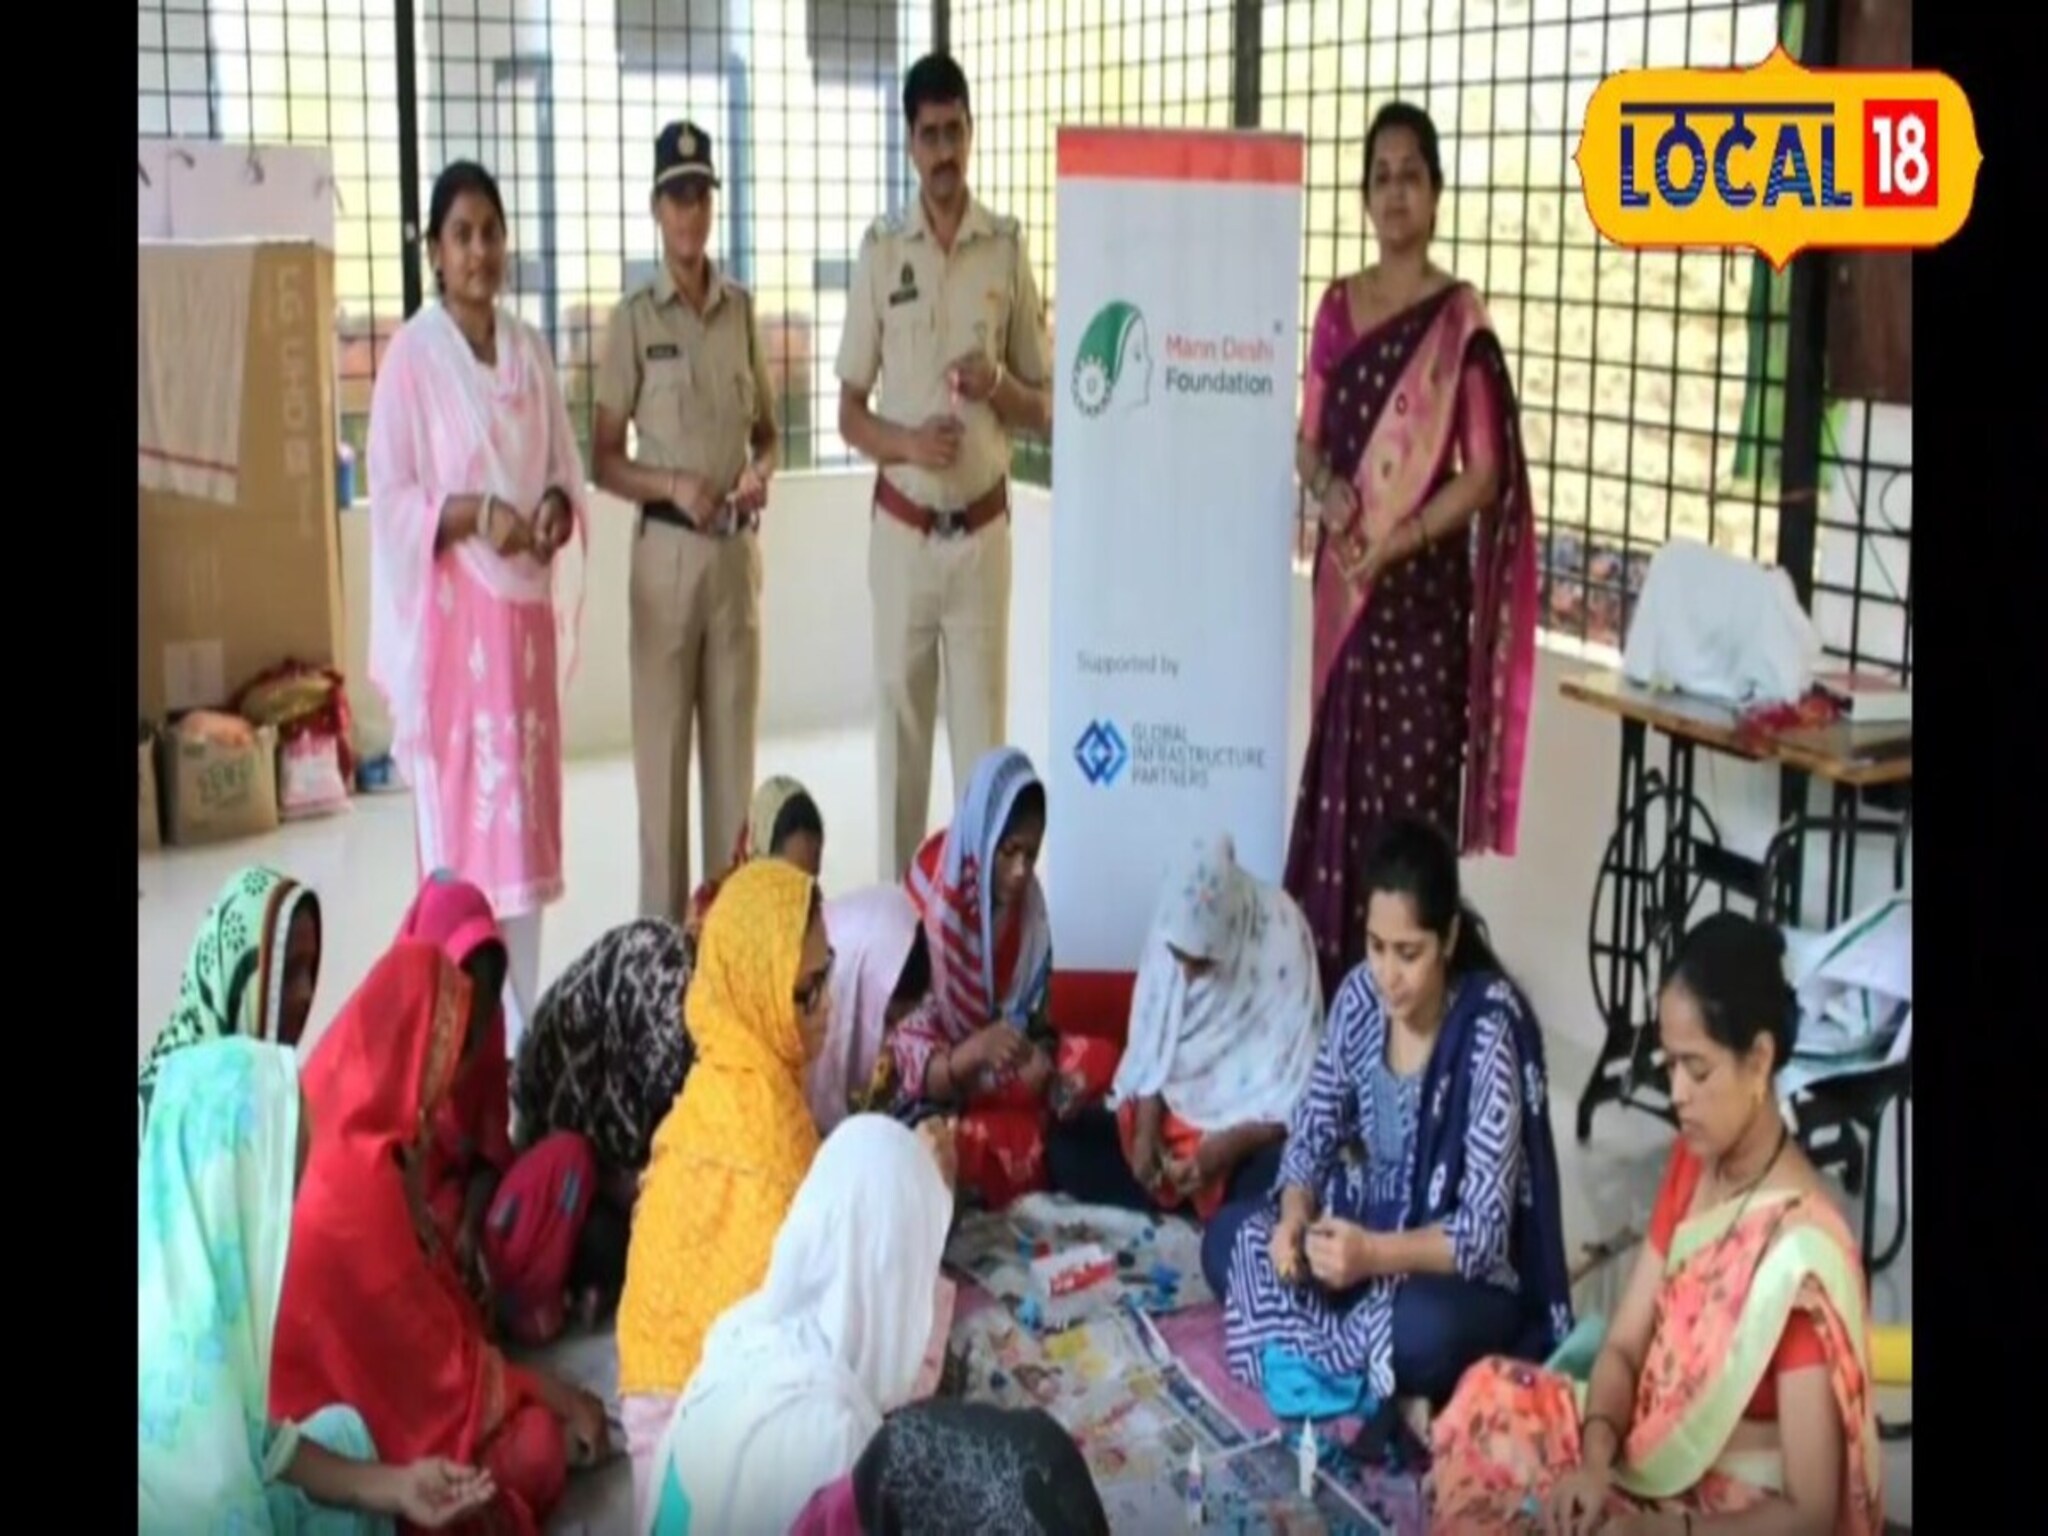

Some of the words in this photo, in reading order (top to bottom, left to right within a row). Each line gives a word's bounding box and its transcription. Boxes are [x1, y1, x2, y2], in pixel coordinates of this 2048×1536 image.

[1165, 333, 1217, 359] Mann
[1222, 335, 1274, 362] Deshi
[1165, 366, 1273, 396] Foundation
[1076, 650, 1156, 675] Supported
[1161, 653, 1179, 677] by
[1132, 723, 1187, 743] GLOBAL
[1132, 743, 1265, 769] INFRASTRUCTURE
[1132, 766, 1209, 789] PARTNERS
